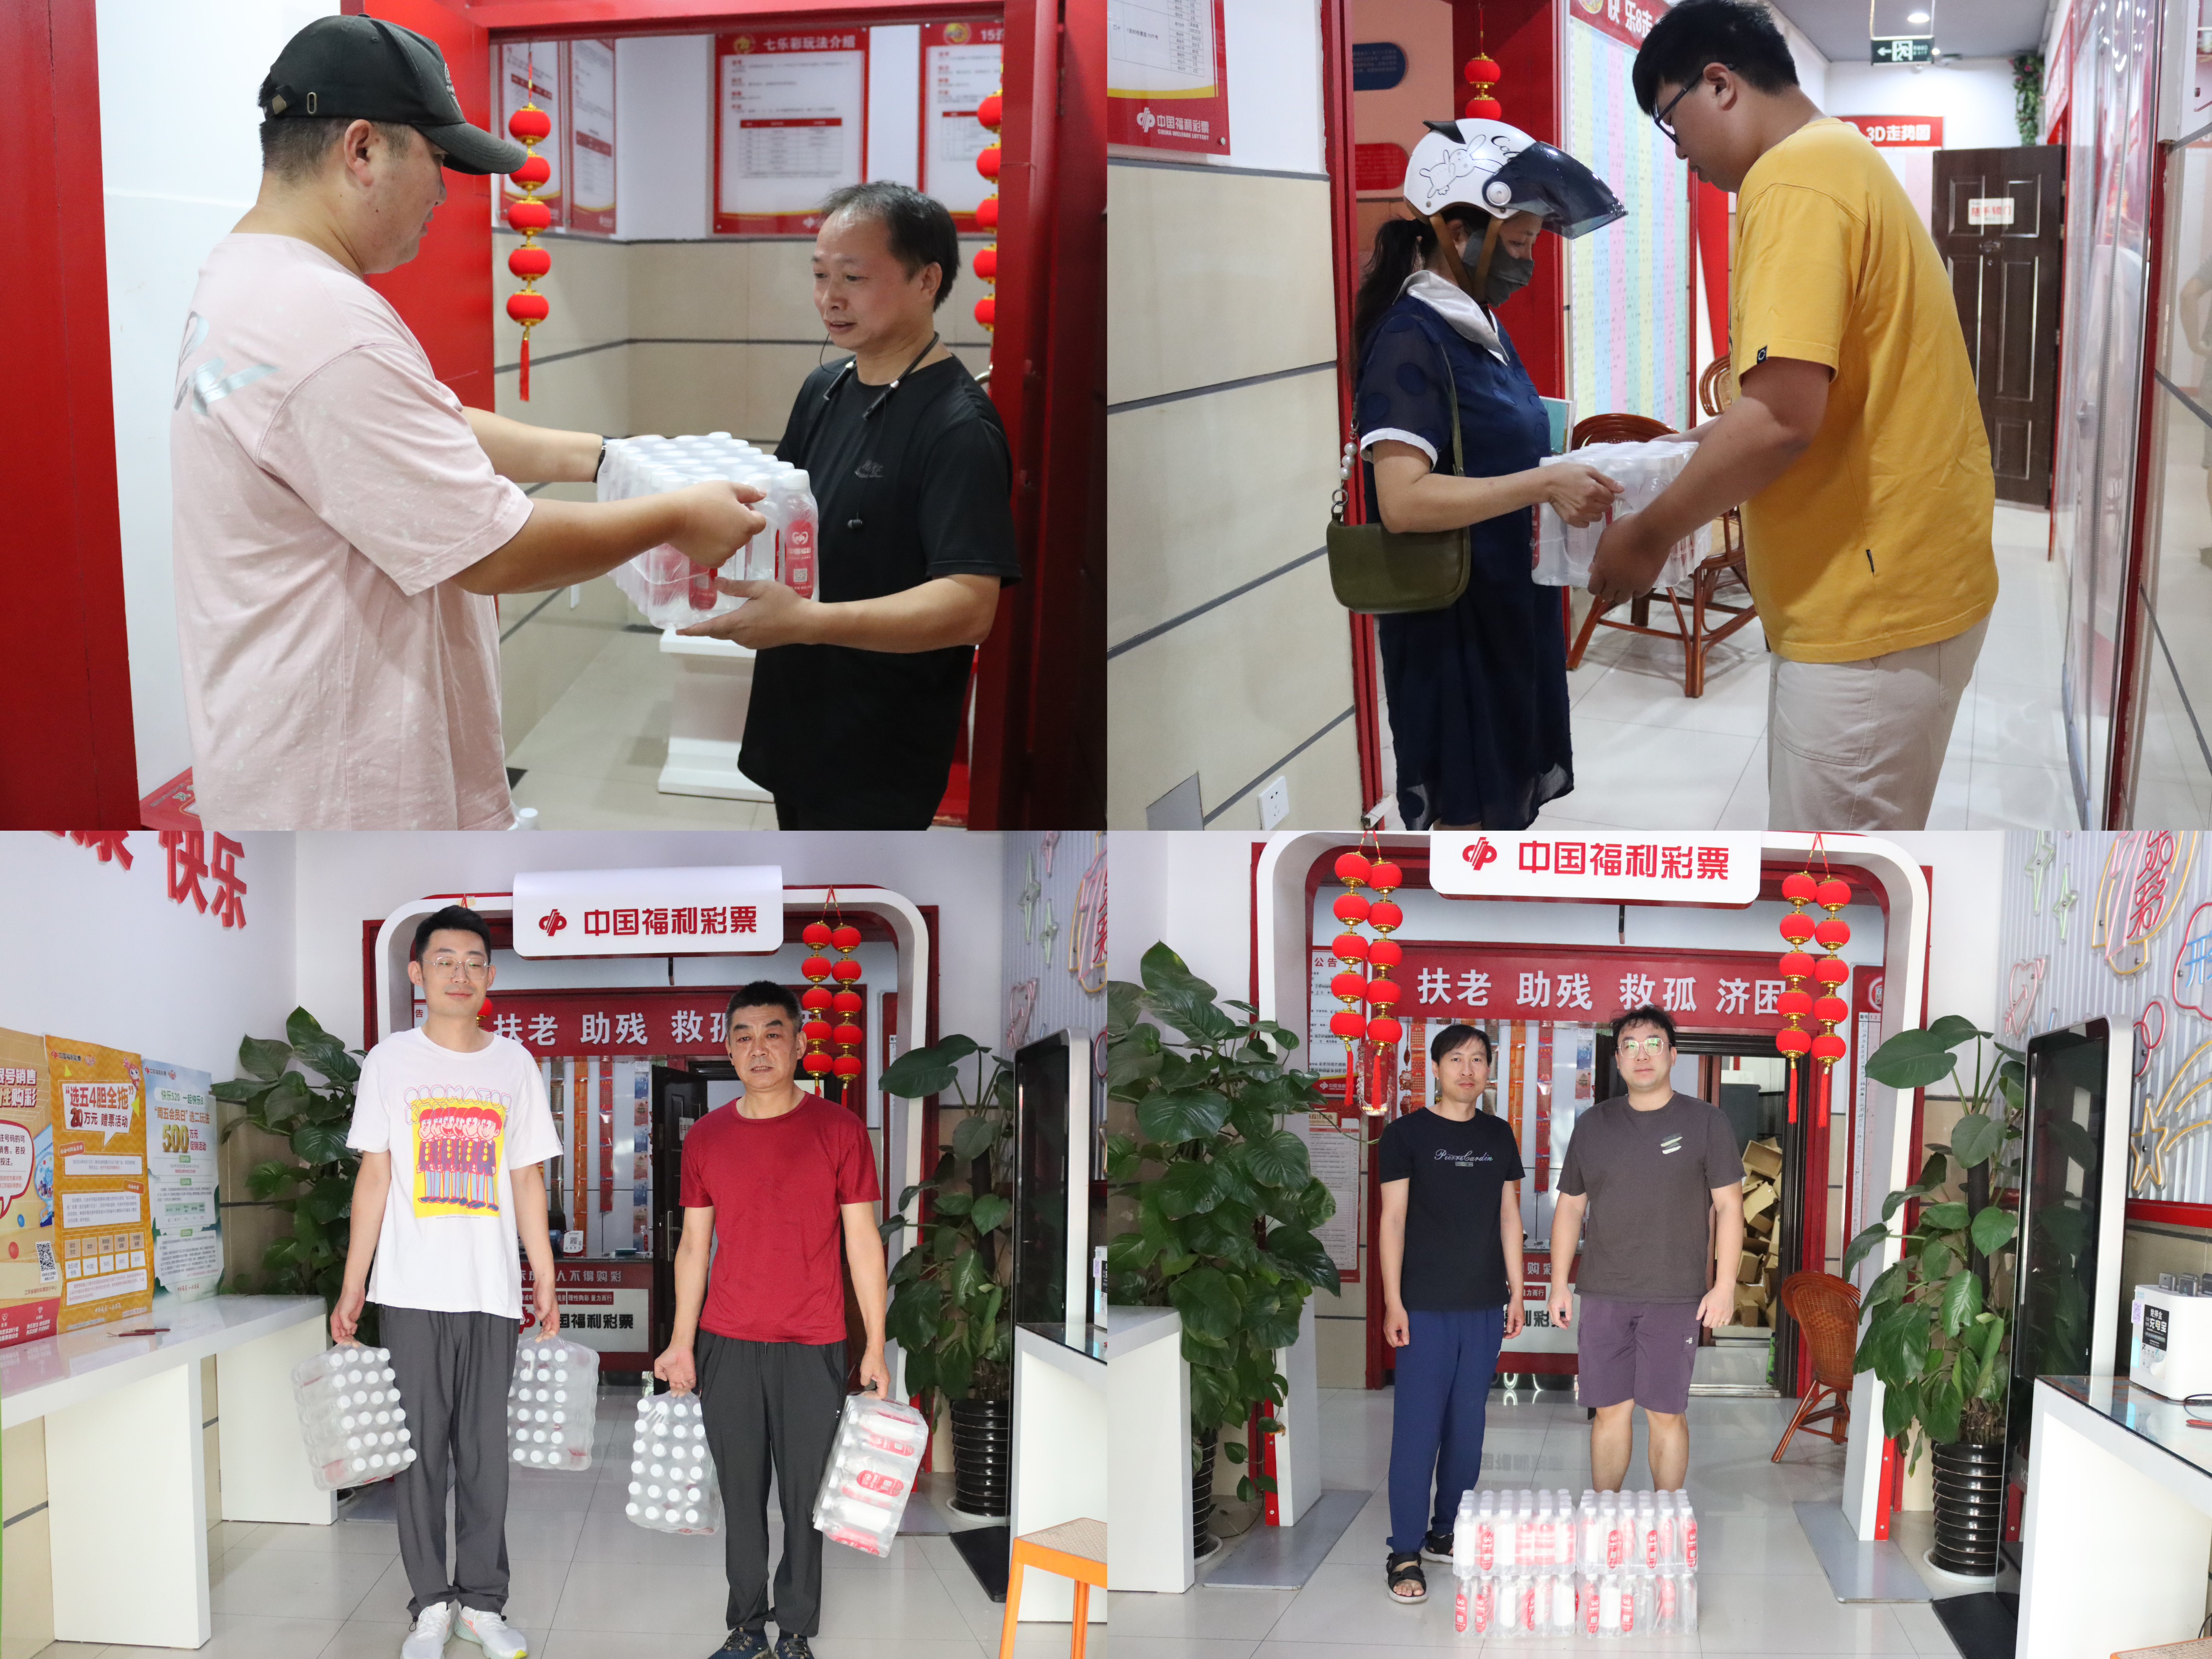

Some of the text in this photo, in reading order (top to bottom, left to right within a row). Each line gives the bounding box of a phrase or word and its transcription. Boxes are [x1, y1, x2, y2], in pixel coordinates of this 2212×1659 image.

[763, 35, 856, 51] 七乐彩玩法介绍
[1157, 115, 1209, 134] 中国福利彩票
[1519, 840, 1729, 880] 中国福利彩票
[584, 906, 757, 937] 中国福利彩票
[1314, 957, 1337, 968] 公告
[1417, 967, 1491, 1007] 扶老
[1516, 970, 1593, 1011] 助残
[1619, 973, 1697, 1012] 救孤
[493, 1013, 558, 1046] 扶老
[580, 1011, 648, 1045] 助残
[59, 1052, 81, 1062] 中国福利彩票
[101, 1113, 128, 1128] 赠票活动
[162, 1124, 189, 1153] 500
[540, 1313, 634, 1329] 国福利彩票
[2150, 1308, 2163, 1320] 免押金
[2149, 1318, 2167, 1333] 充电宝
